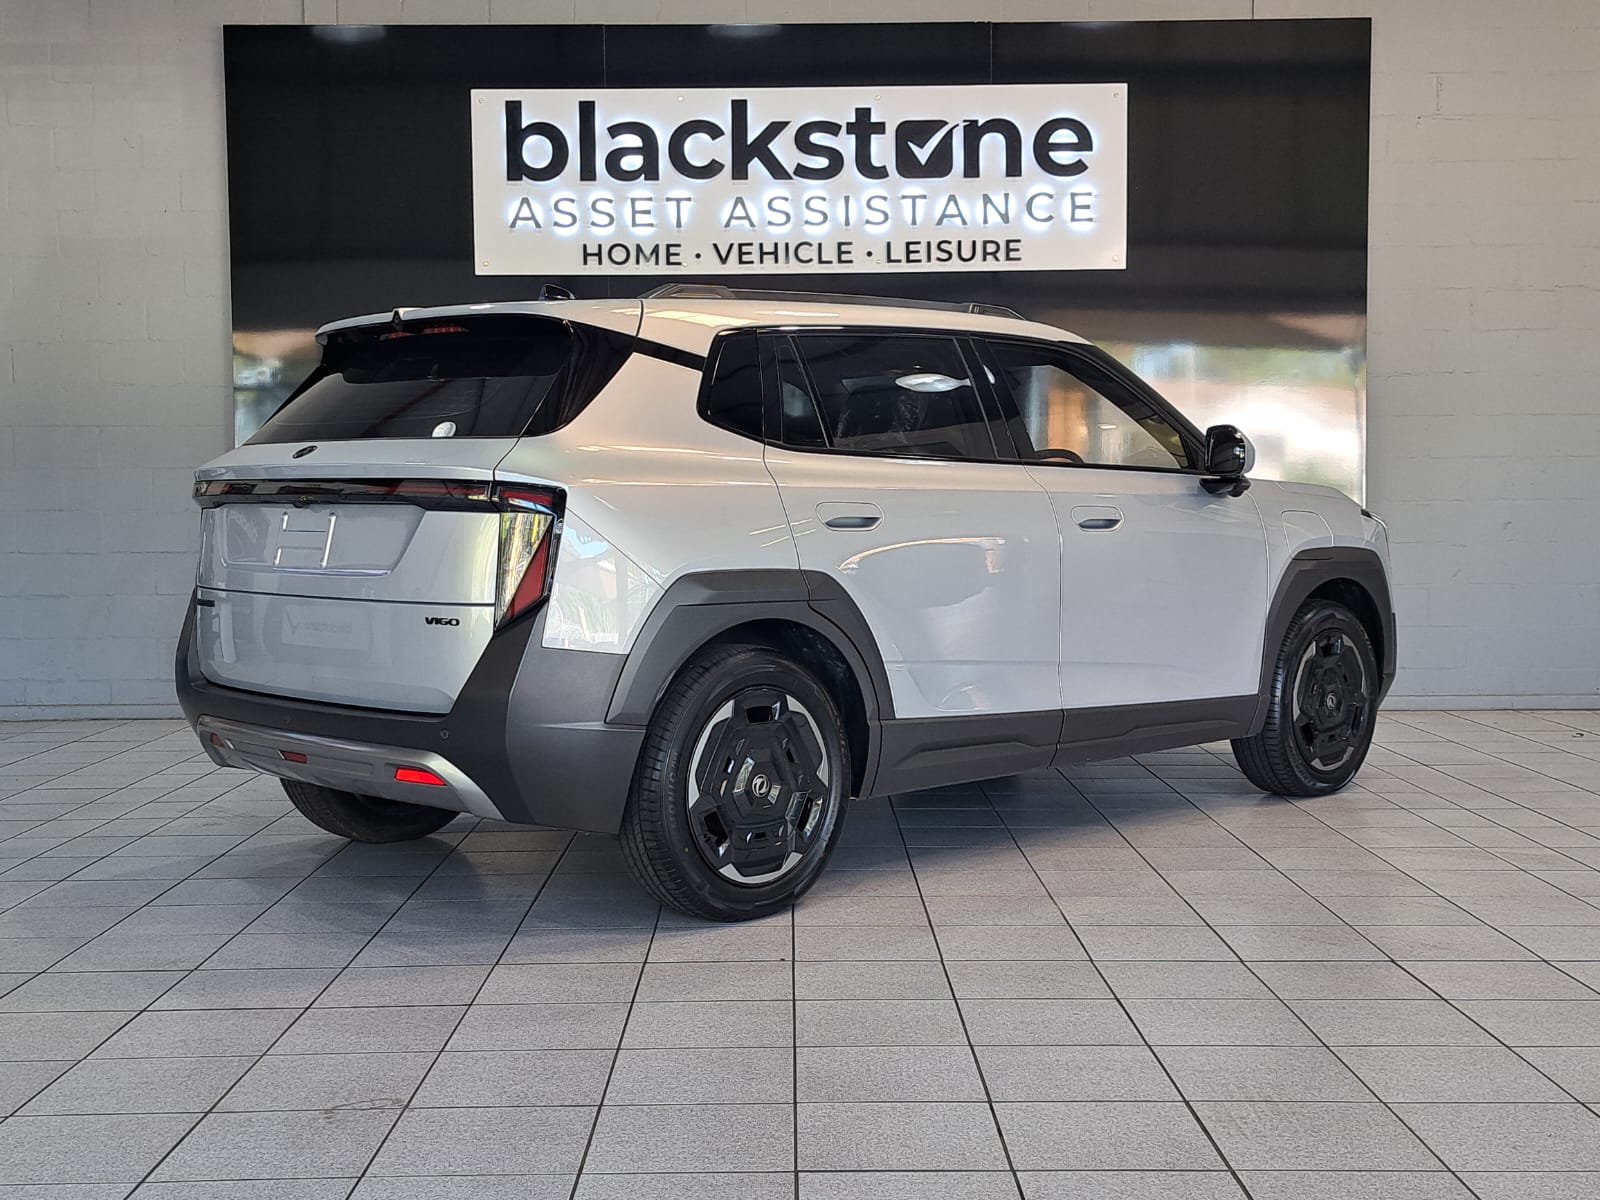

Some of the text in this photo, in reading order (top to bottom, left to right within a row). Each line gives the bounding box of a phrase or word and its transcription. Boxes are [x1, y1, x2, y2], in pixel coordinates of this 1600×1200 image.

[509, 193, 1094, 229] ASSET ASSISTANCE
[582, 239, 1022, 266] HOME VEHICLE LEISURE
[425, 617, 460, 626] VIGO
